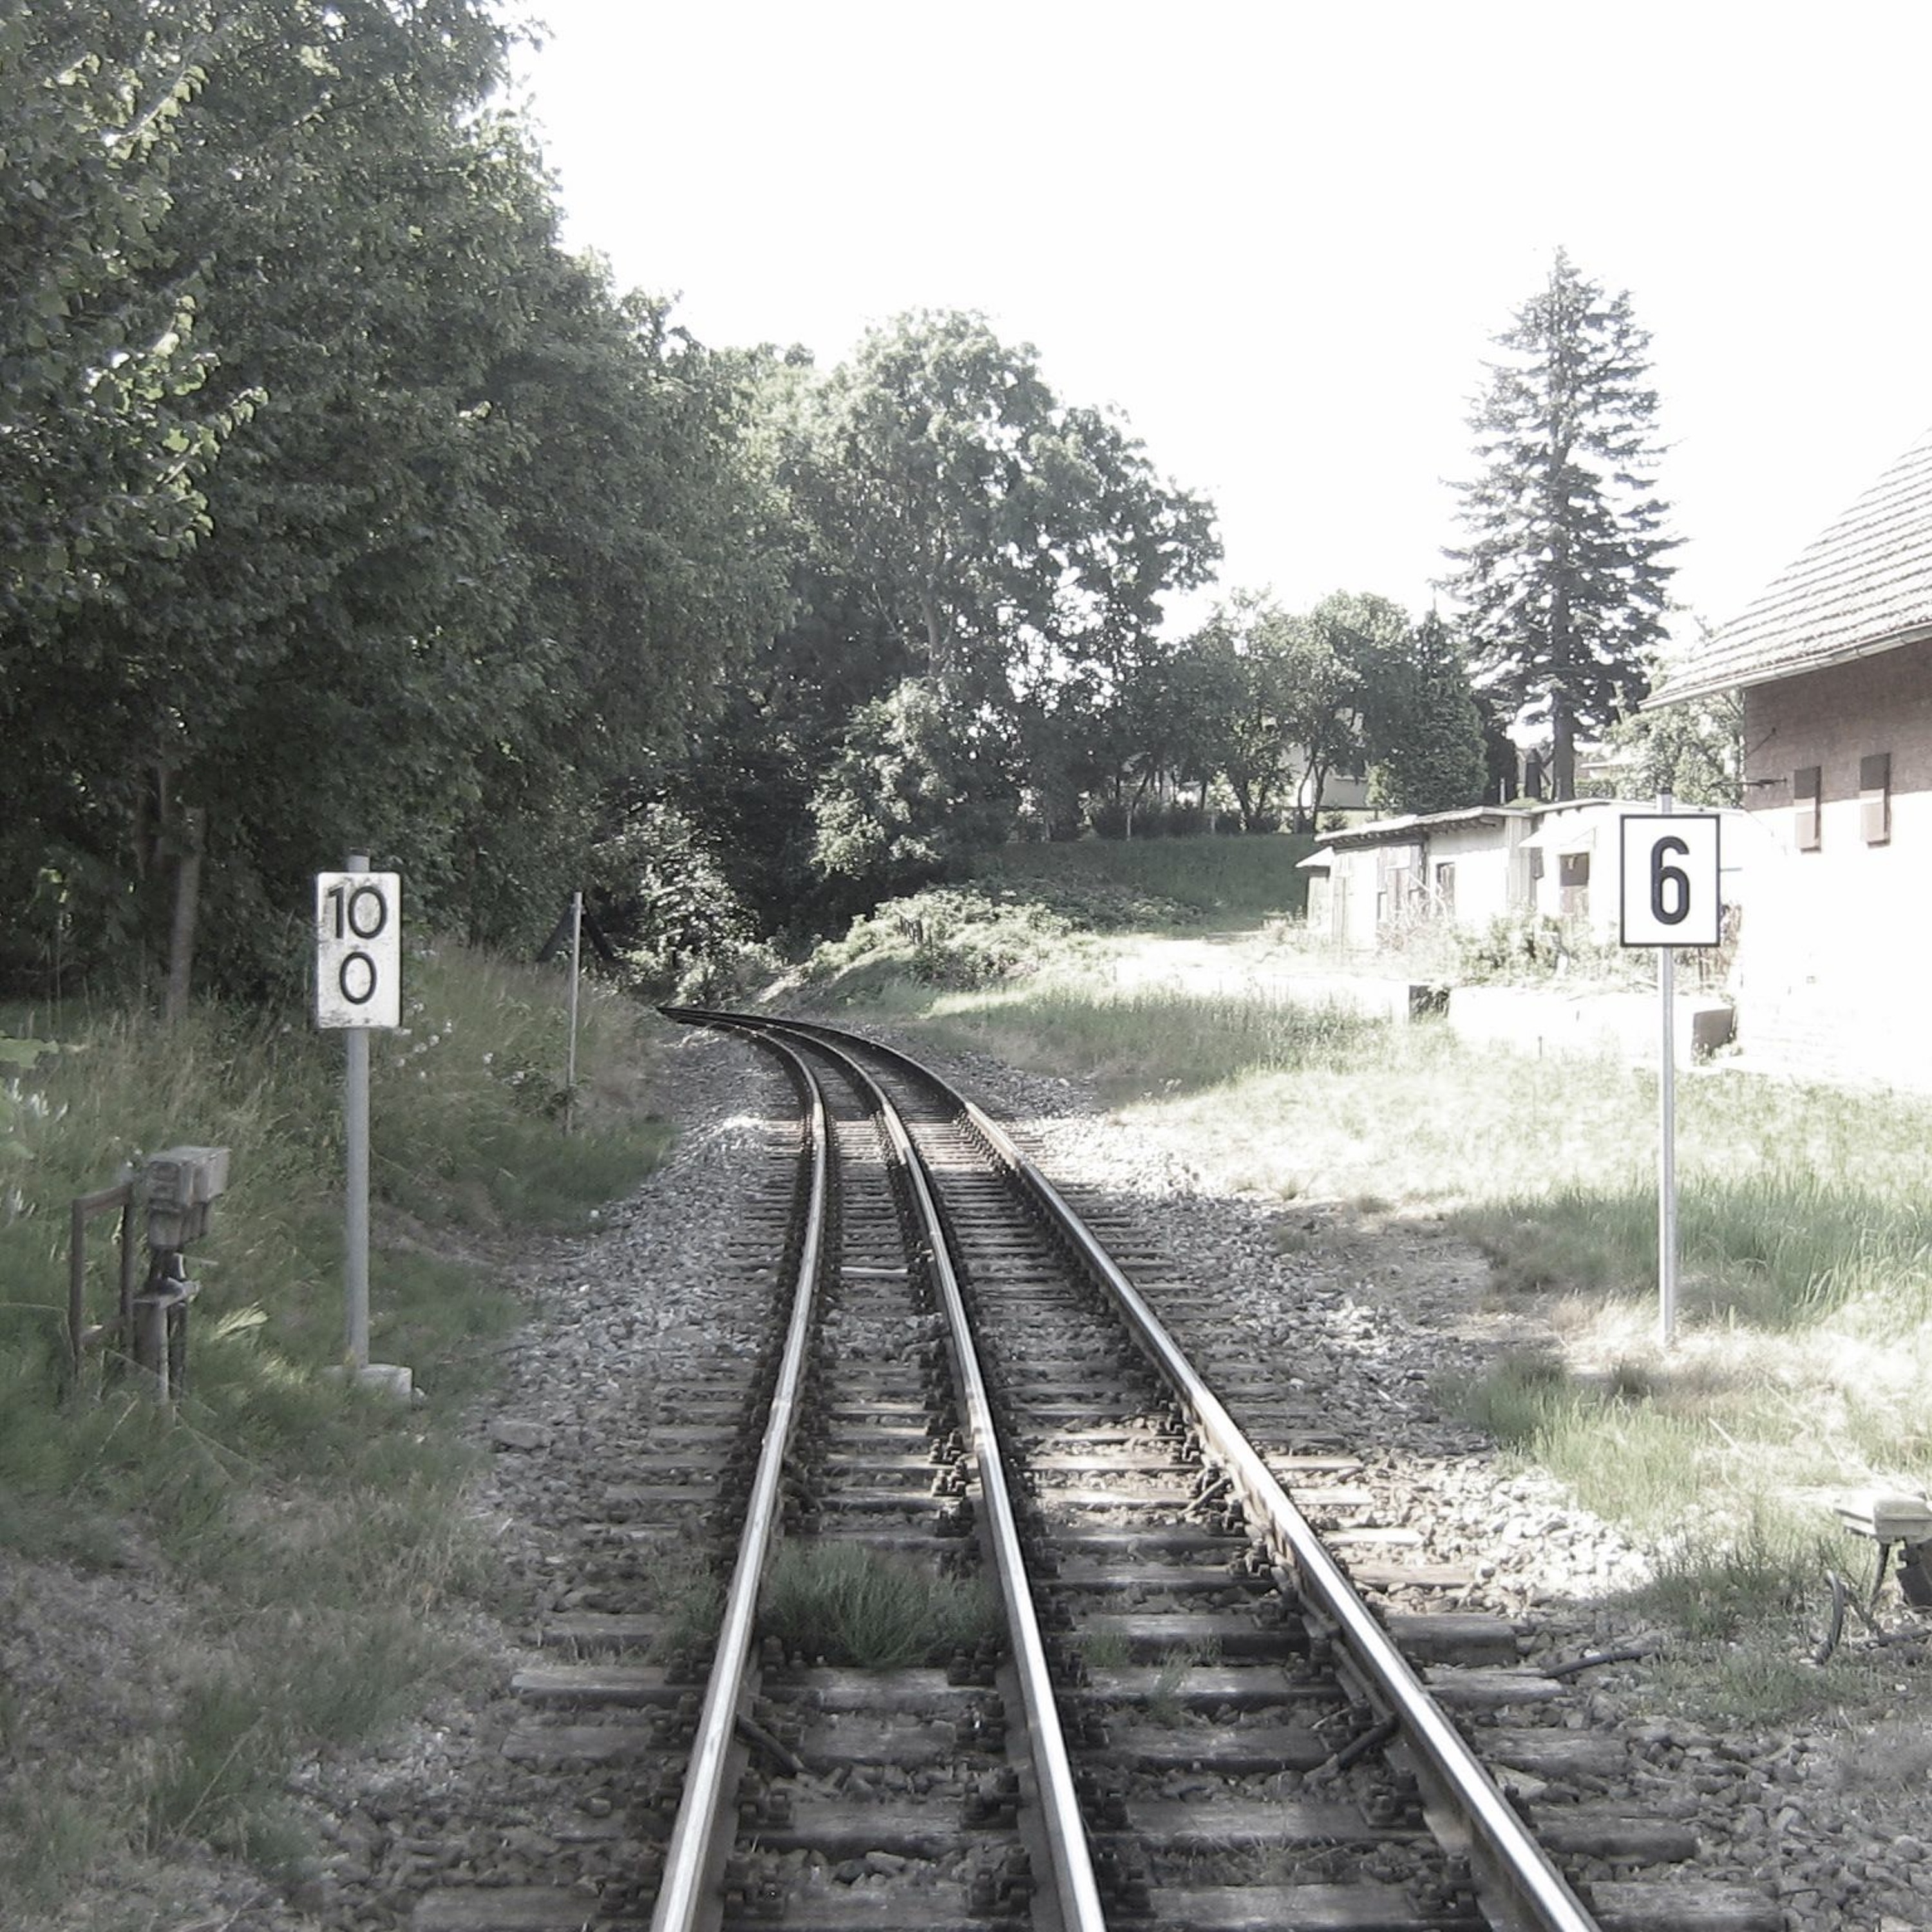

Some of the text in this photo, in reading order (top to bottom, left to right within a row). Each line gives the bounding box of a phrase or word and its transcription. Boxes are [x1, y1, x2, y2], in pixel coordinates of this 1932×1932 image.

[1651, 835, 1690, 926] 6
[327, 886, 388, 940] 10
[339, 951, 377, 1005] 0
